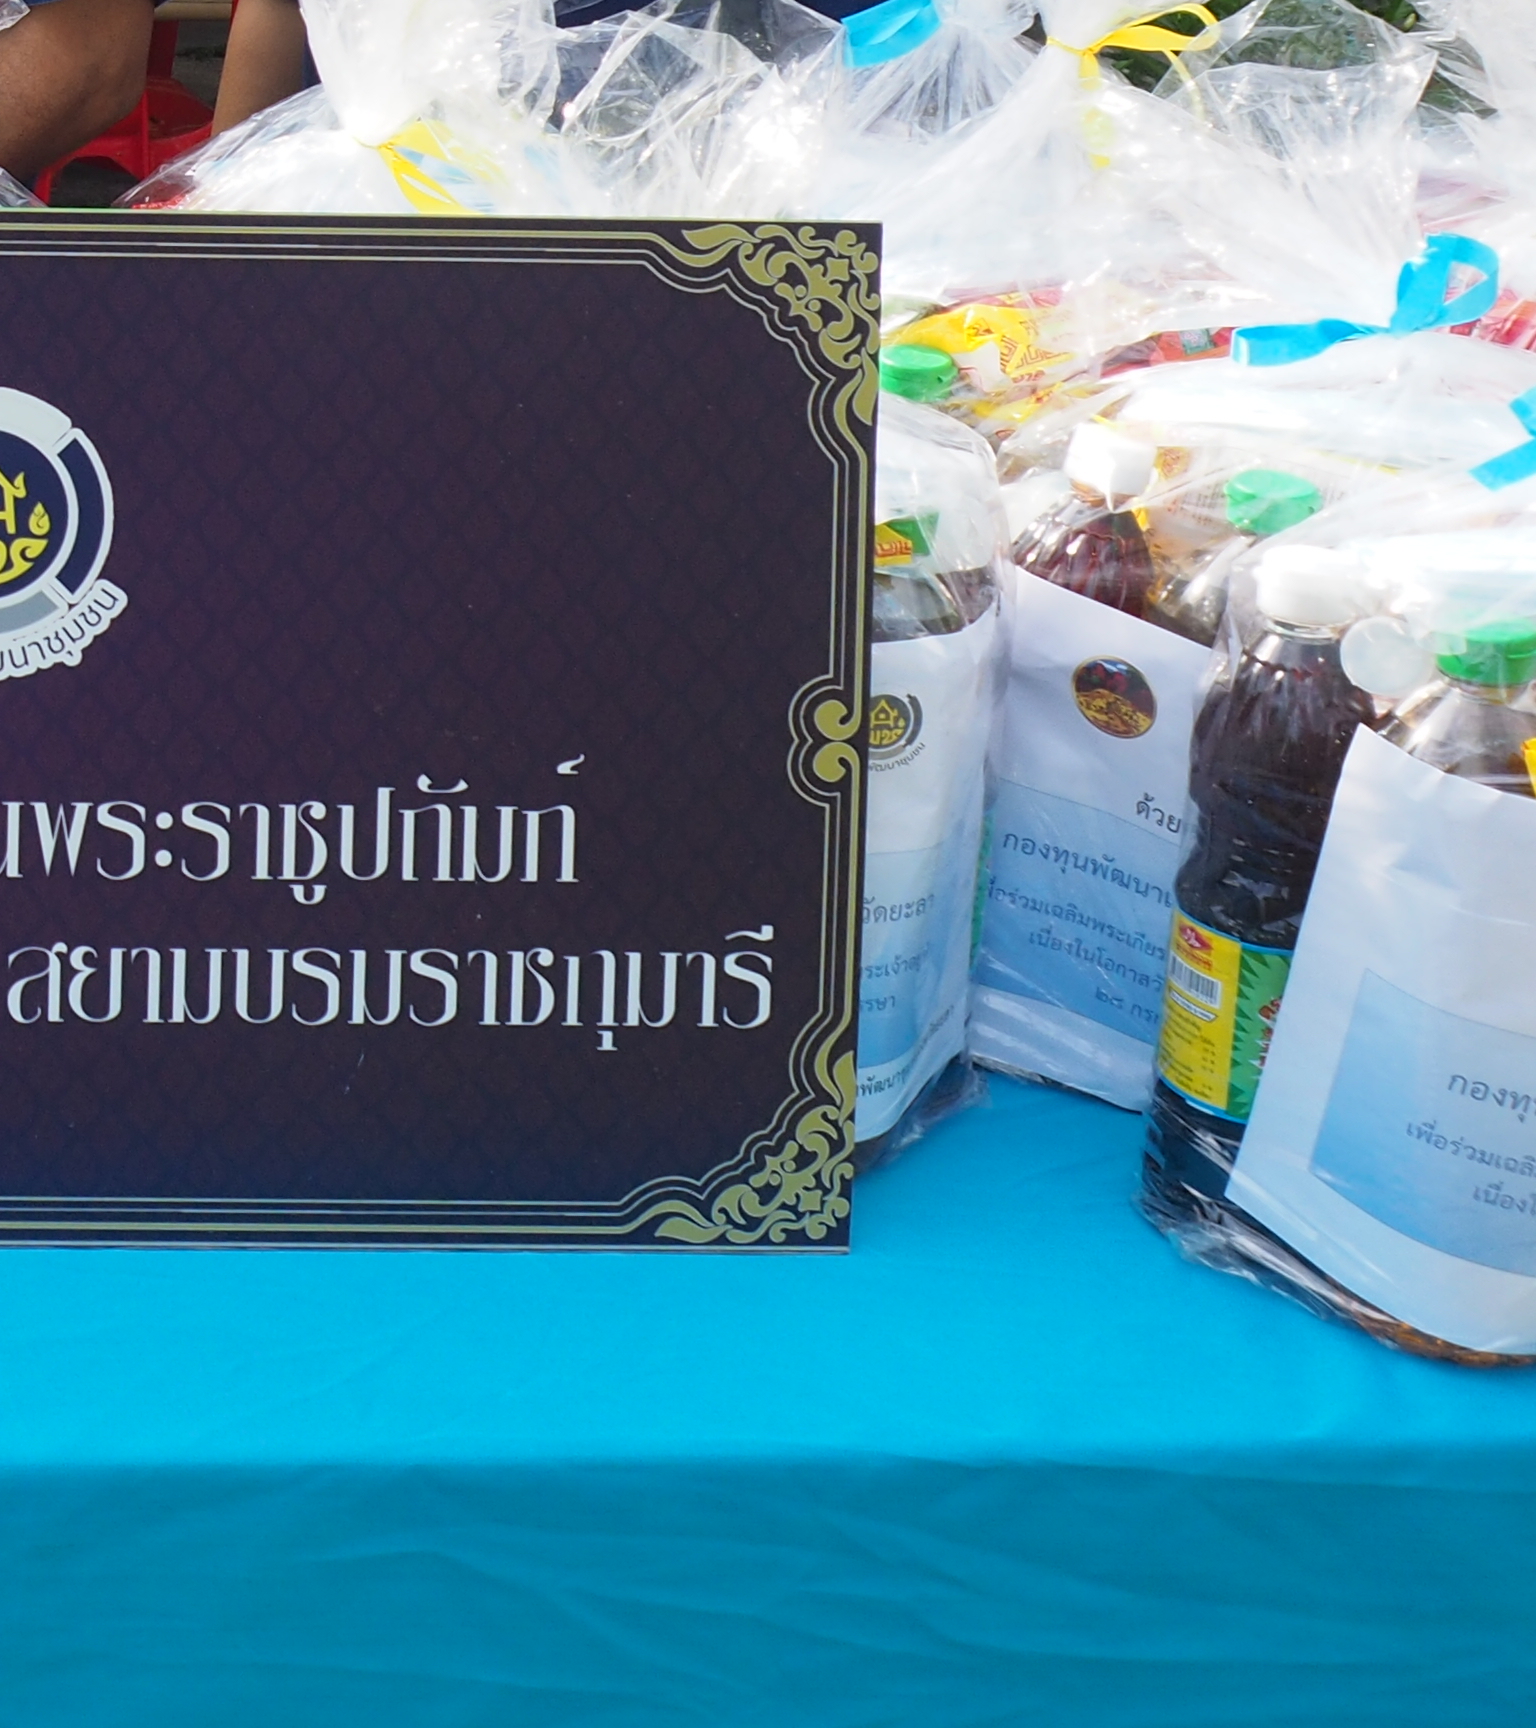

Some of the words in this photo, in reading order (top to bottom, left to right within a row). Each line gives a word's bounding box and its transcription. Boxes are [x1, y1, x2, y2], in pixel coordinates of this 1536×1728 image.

[6, 924, 776, 1052] สยามบรมราชกุมารี
[1447, 1073, 1536, 1123] กองทุ
